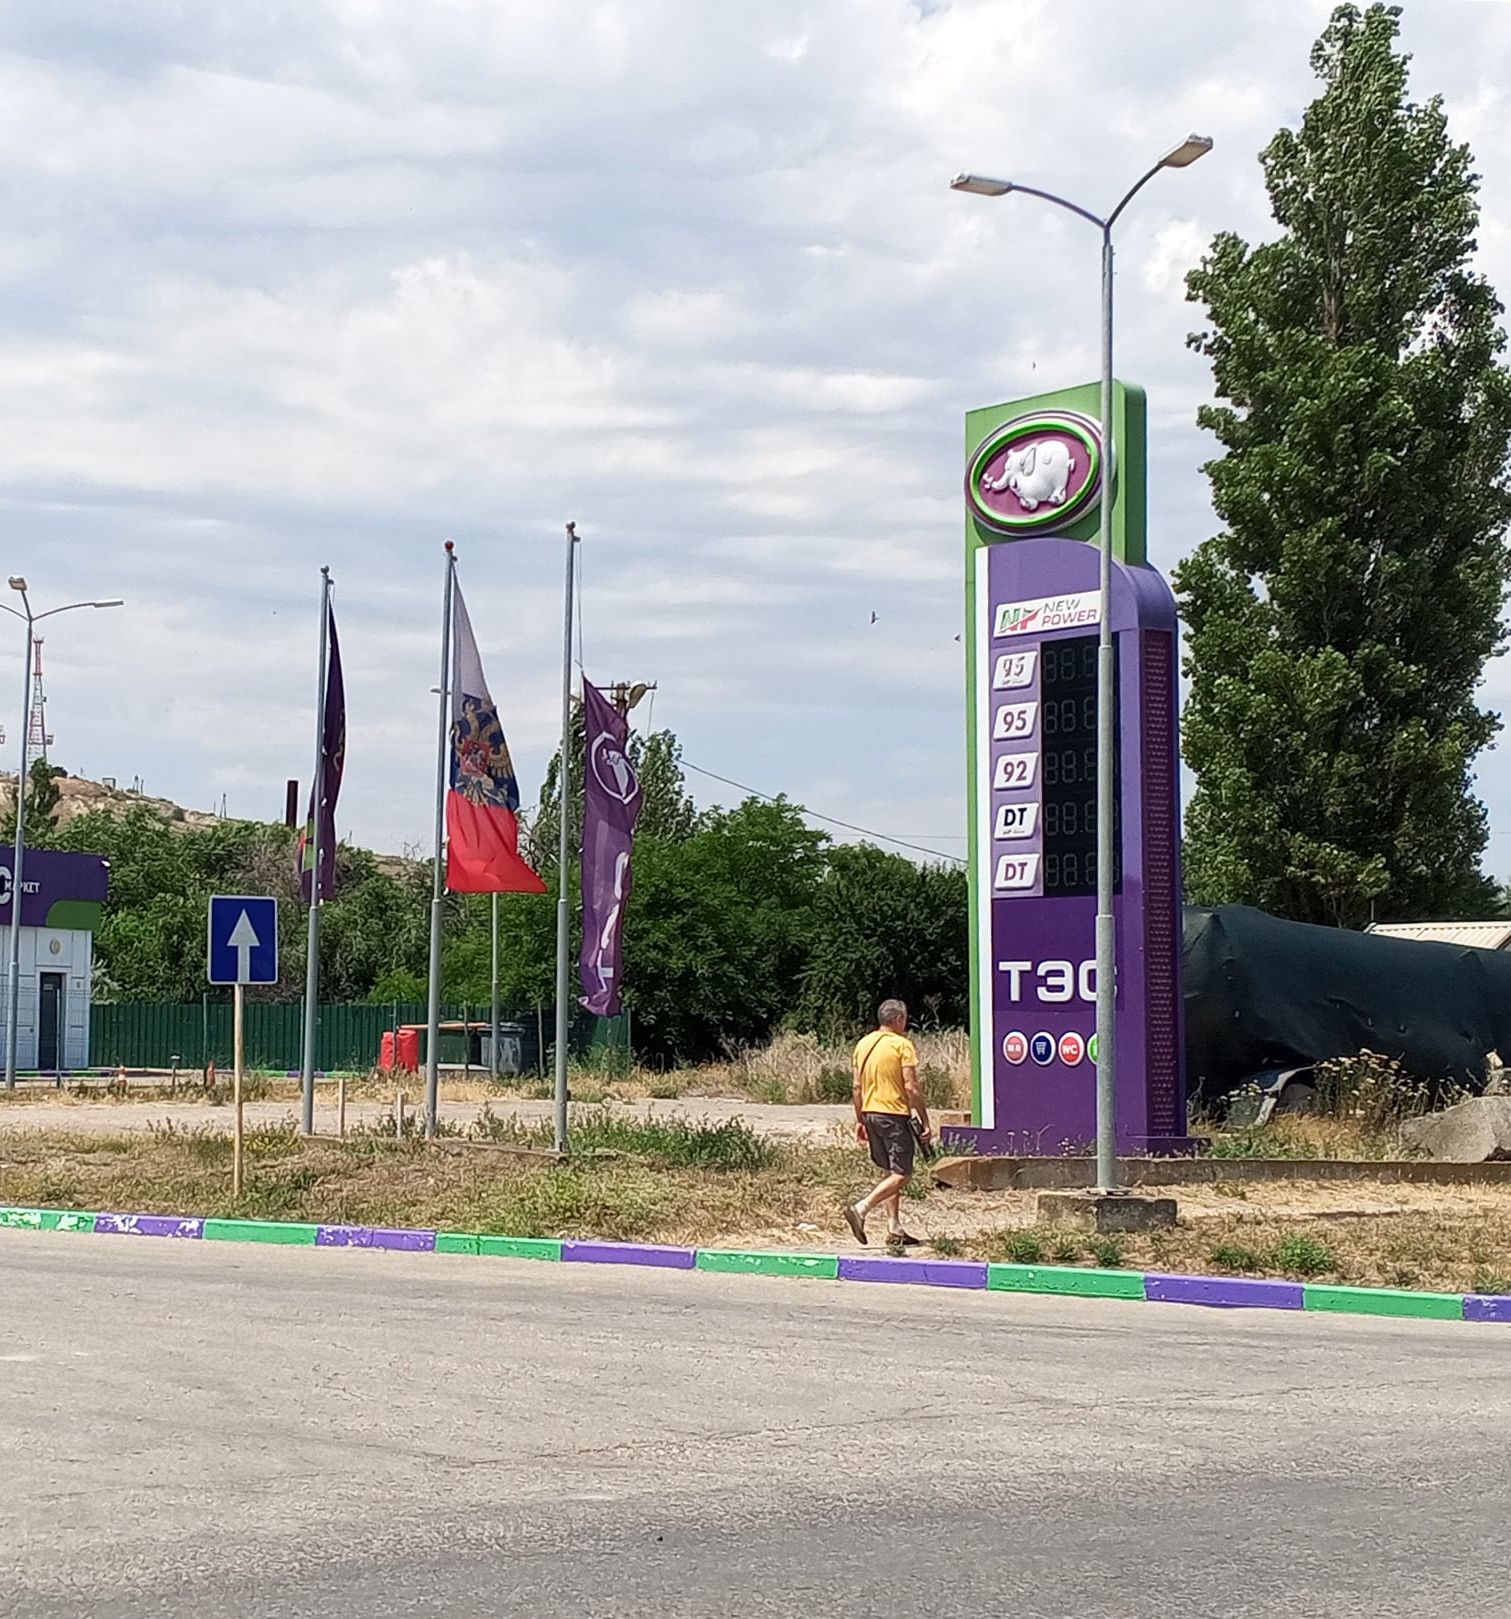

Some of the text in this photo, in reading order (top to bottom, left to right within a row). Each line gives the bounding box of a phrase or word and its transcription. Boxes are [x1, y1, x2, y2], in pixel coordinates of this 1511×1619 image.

[1043, 599, 1081, 614] NEW
[1042, 608, 1098, 626] POWER
[1003, 710, 1027, 733] 95
[1003, 760, 1027, 782] 92
[1003, 807, 1027, 827] DT
[1004, 862, 1028, 881] DT
[4, 879, 41, 894] МКЕТ
